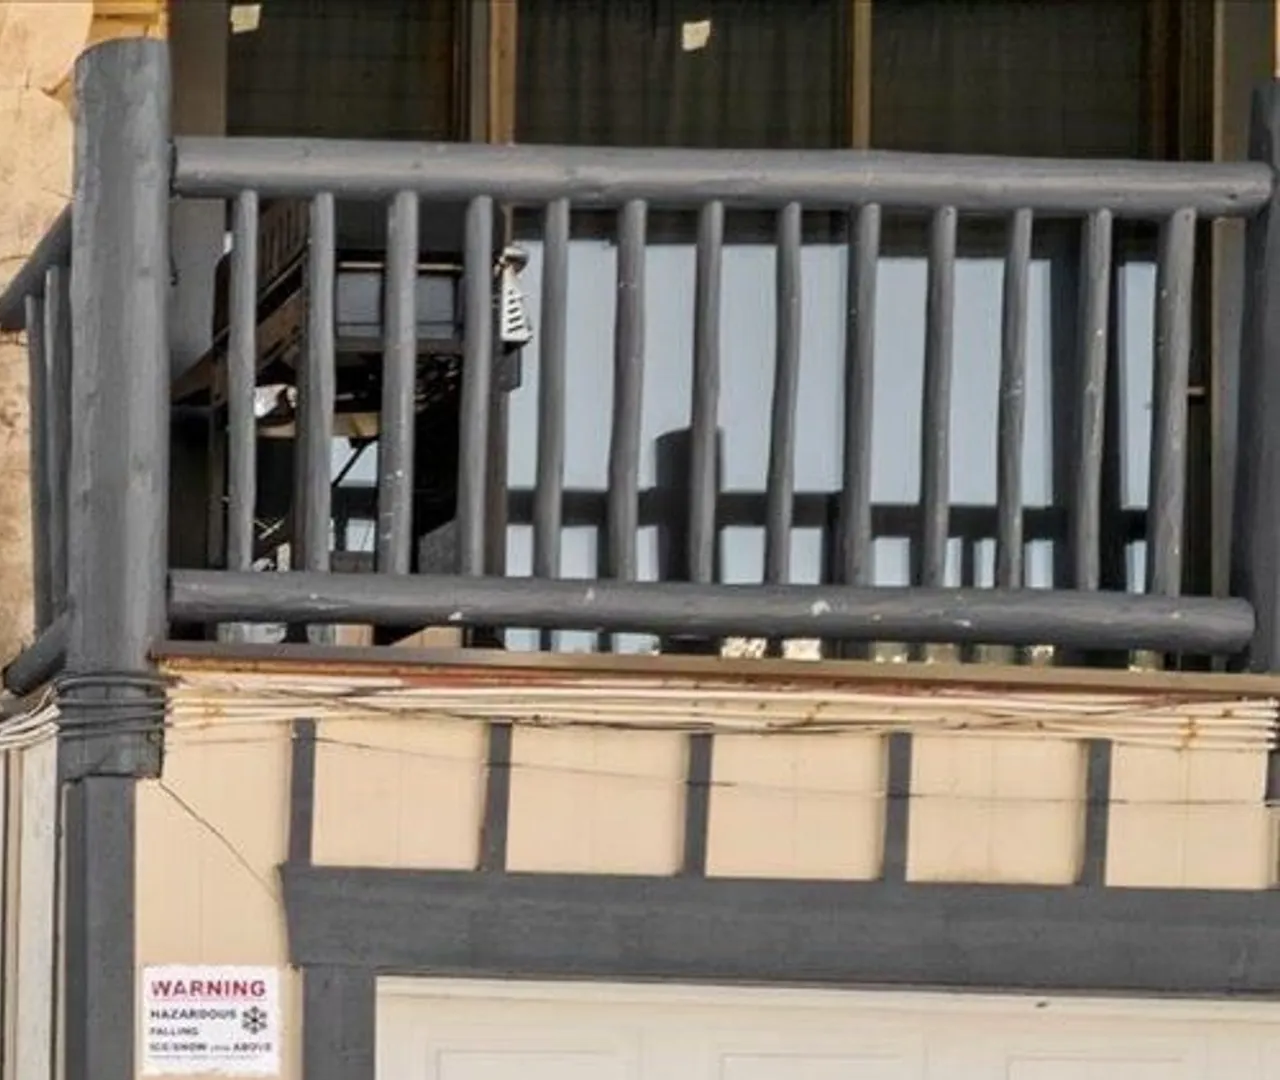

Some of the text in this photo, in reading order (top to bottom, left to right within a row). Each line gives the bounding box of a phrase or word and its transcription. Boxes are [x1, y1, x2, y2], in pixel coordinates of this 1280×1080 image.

[151, 980, 266, 997] WARNING
[150, 1009, 237, 1020] HAZARDOUS
[149, 1027, 199, 1036] FALLING
[233, 1042, 272, 1052] ABOVE
